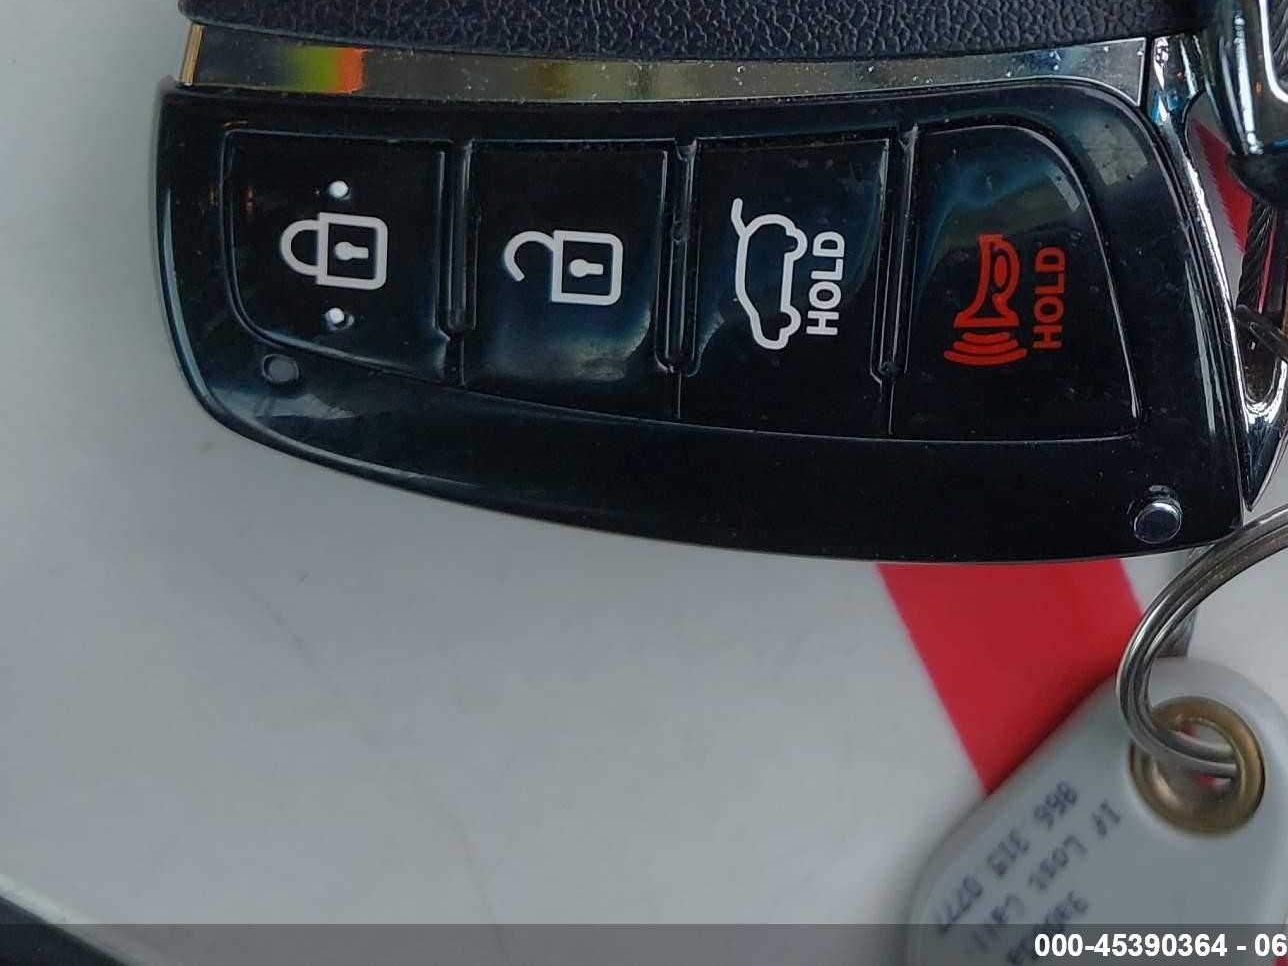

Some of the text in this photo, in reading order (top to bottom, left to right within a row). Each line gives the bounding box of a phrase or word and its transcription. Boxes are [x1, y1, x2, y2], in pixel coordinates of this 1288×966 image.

[806, 231, 845, 336] HOLD
[1033, 246, 1066, 349] HOLD
[1027, 835, 1087, 891] Lost
